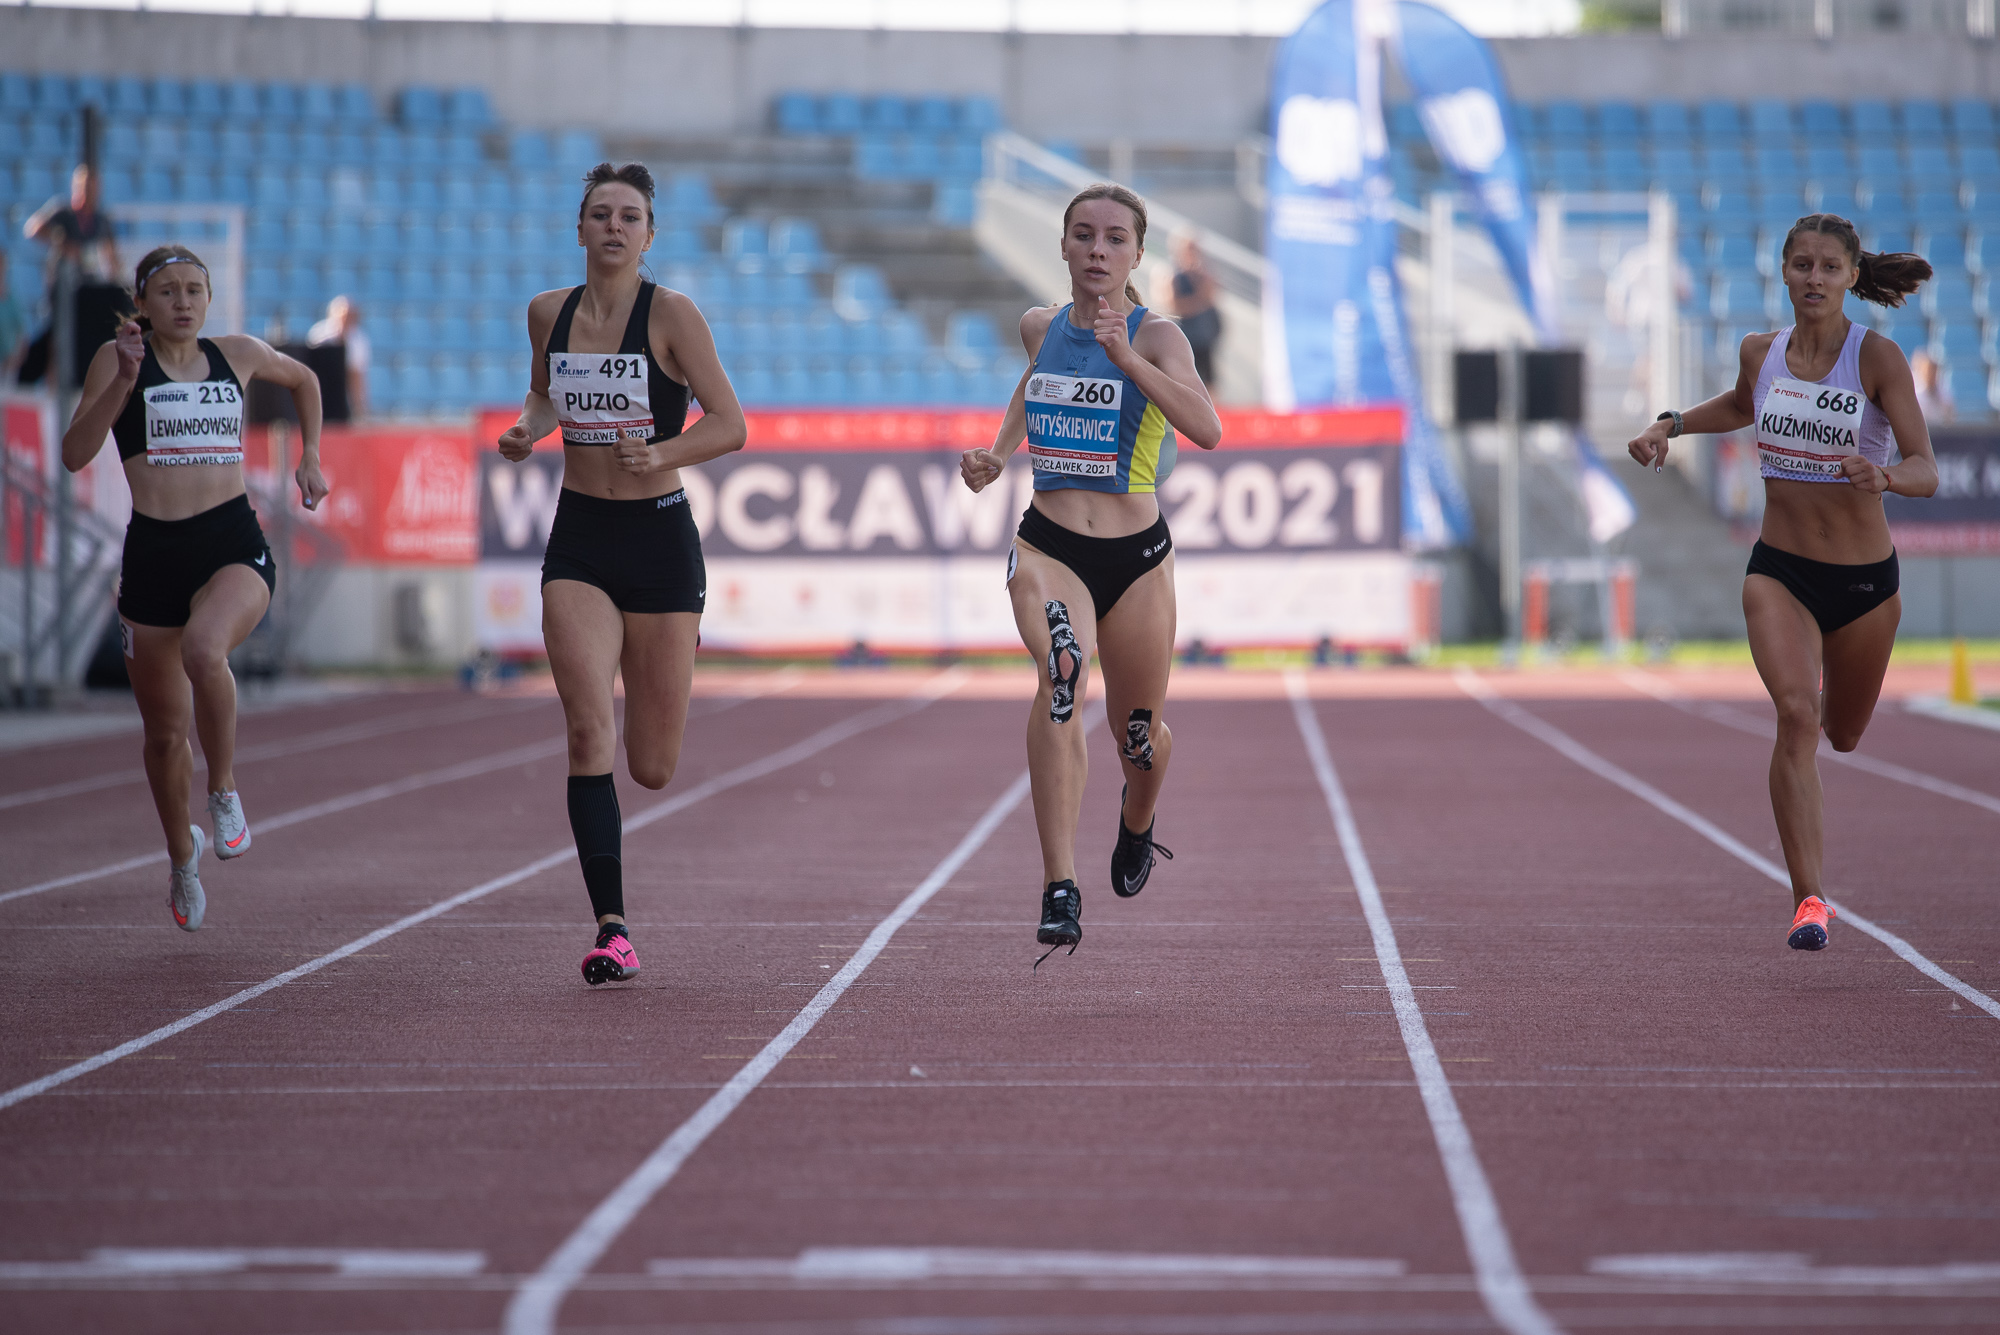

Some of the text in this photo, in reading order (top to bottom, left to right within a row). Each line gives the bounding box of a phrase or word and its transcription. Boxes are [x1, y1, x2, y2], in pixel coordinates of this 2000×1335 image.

[599, 358, 641, 378] 491
[198, 386, 236, 404] 213
[565, 392, 630, 411] PUZIO
[1071, 381, 1115, 405] 260
[1816, 390, 1858, 415] 668
[151, 417, 238, 438] LEWANDOWSKA
[626, 429, 649, 438] 2021
[1027, 411, 1116, 442] MATYŚKIEWICZ
[1761, 412, 1855, 447] KUŹMIŃSKA
[154, 455, 240, 466] WŁOCŁAWEK 2021
[1031, 457, 1110, 474] WŁOCŁAWEK 2021
[1763, 453, 1825, 473] WŁOCŁAWEK
[657, 492, 682, 509] NIKE
[1165, 458, 1384, 550] 2021
